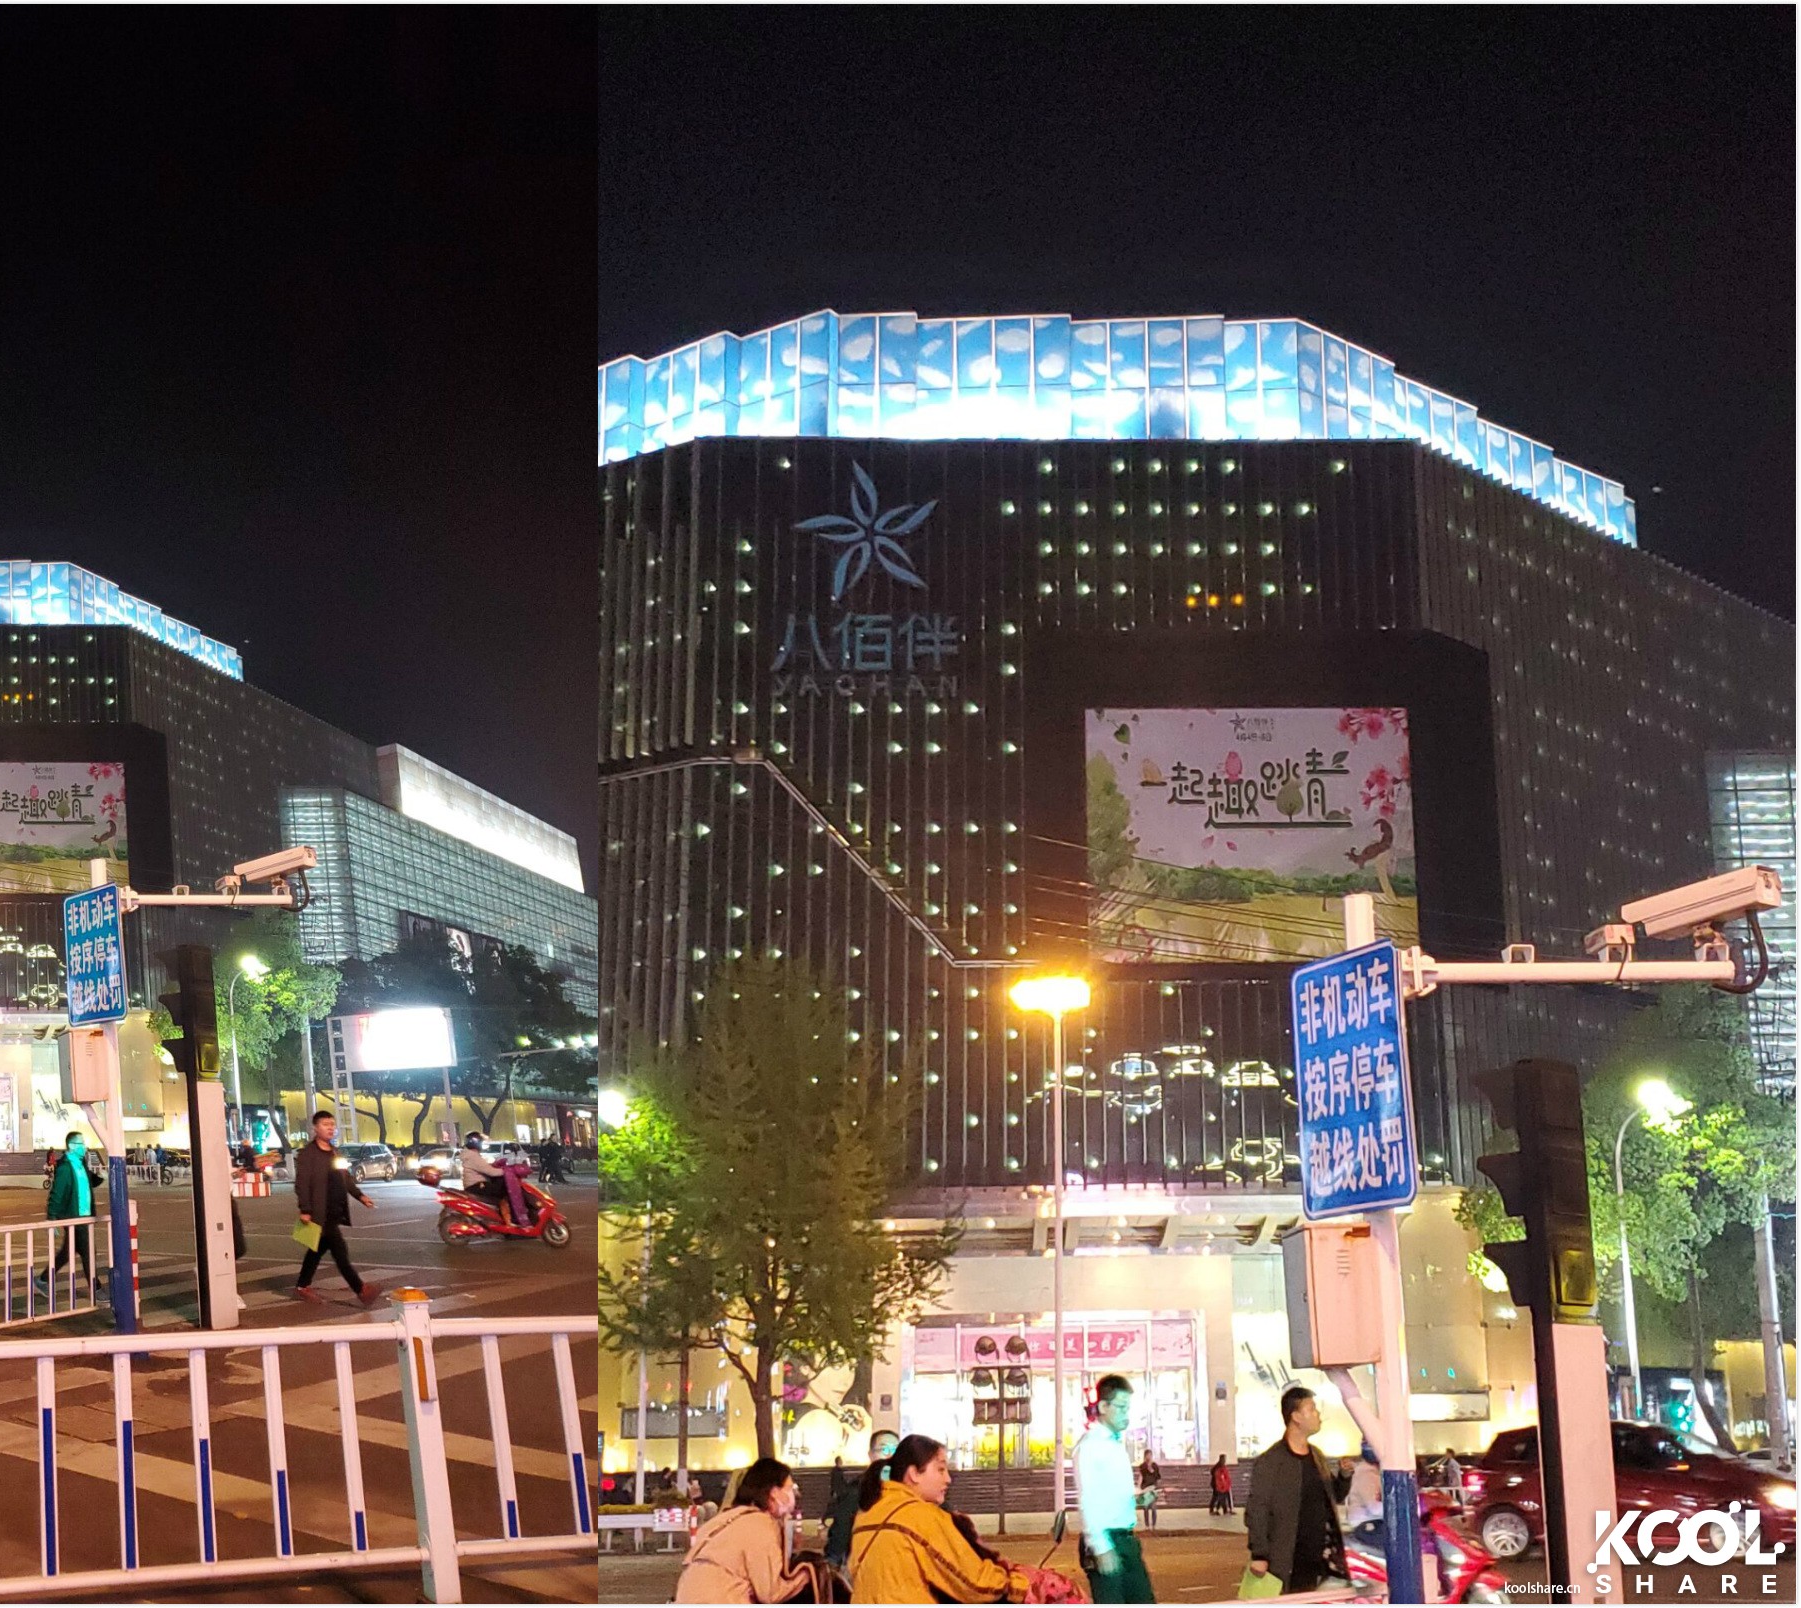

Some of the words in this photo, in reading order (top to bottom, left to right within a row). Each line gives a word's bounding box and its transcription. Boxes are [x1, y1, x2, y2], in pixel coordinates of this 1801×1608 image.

[770, 612, 959, 671] 八佰伴
[772, 673, 959, 697] YAOHAN
[1141, 748, 1353, 829] 一起趣踏青
[68, 892, 116, 936] 非机动车
[70, 933, 119, 976] 按序停车
[72, 974, 122, 1016] 越线处罚
[1300, 957, 1392, 1044] 非机动车
[1304, 1038, 1398, 1121] 按序停车
[1310, 1116, 1405, 1198] 越线处罚
